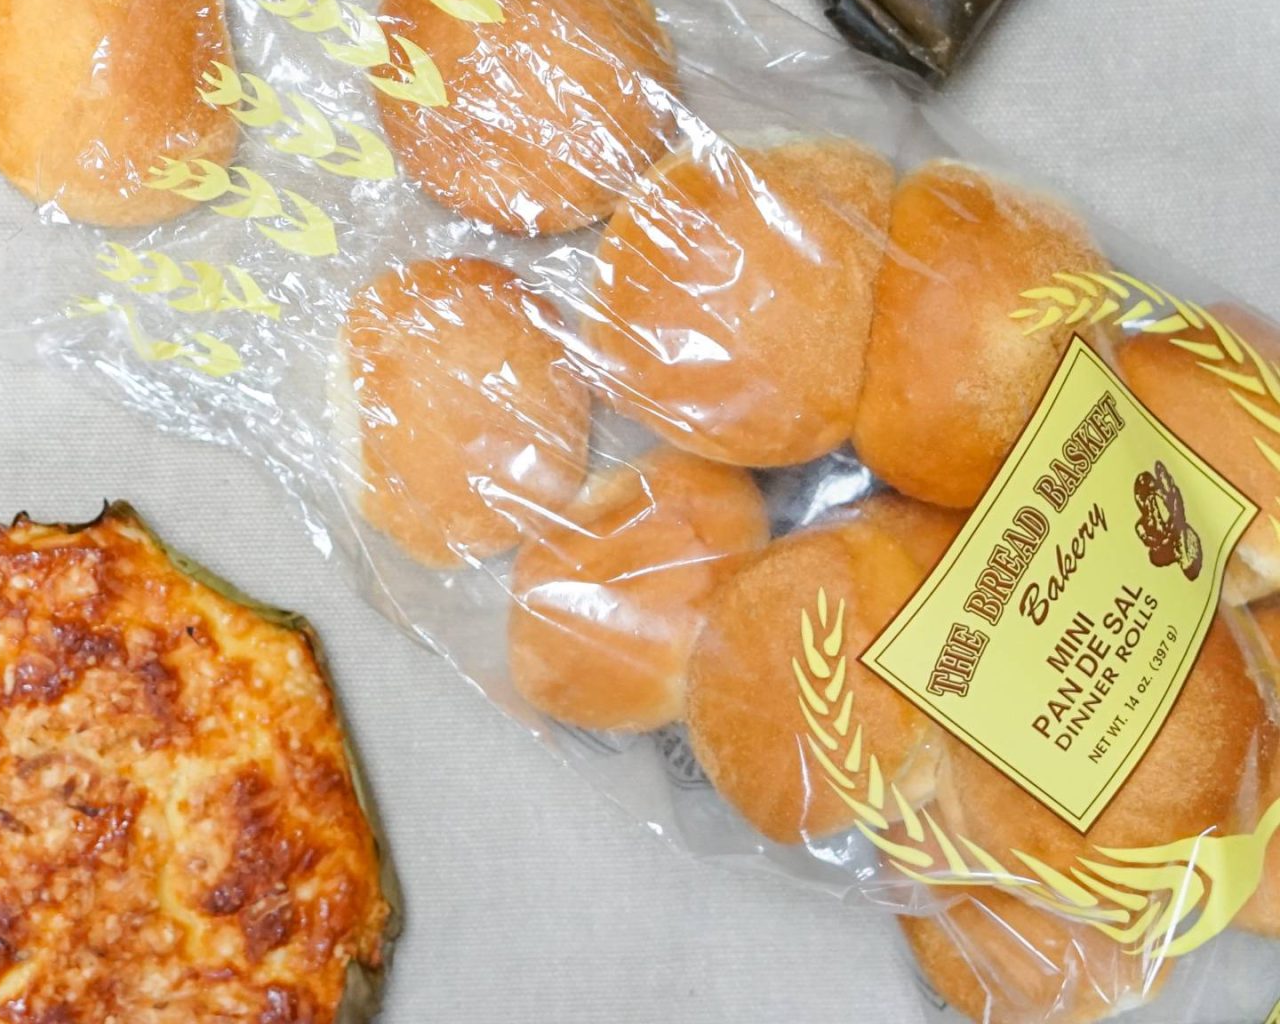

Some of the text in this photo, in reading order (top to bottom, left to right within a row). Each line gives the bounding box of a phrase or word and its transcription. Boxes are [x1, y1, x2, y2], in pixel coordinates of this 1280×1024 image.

[926, 391, 1126, 698] THE BREAD BASKET
[1020, 503, 1108, 626] Bakery
[1032, 585, 1143, 739] PAN DE SAL
[1046, 611, 1095, 674] MINI
[1055, 594, 1158, 752] DINNER ROLLS
[1088, 736, 1111, 764] NET
[1107, 714, 1129, 738] WT.
[1124, 695, 1140, 711] 14
[1137, 675, 1153, 694] oz.
[1149, 640, 1170, 671] (397
